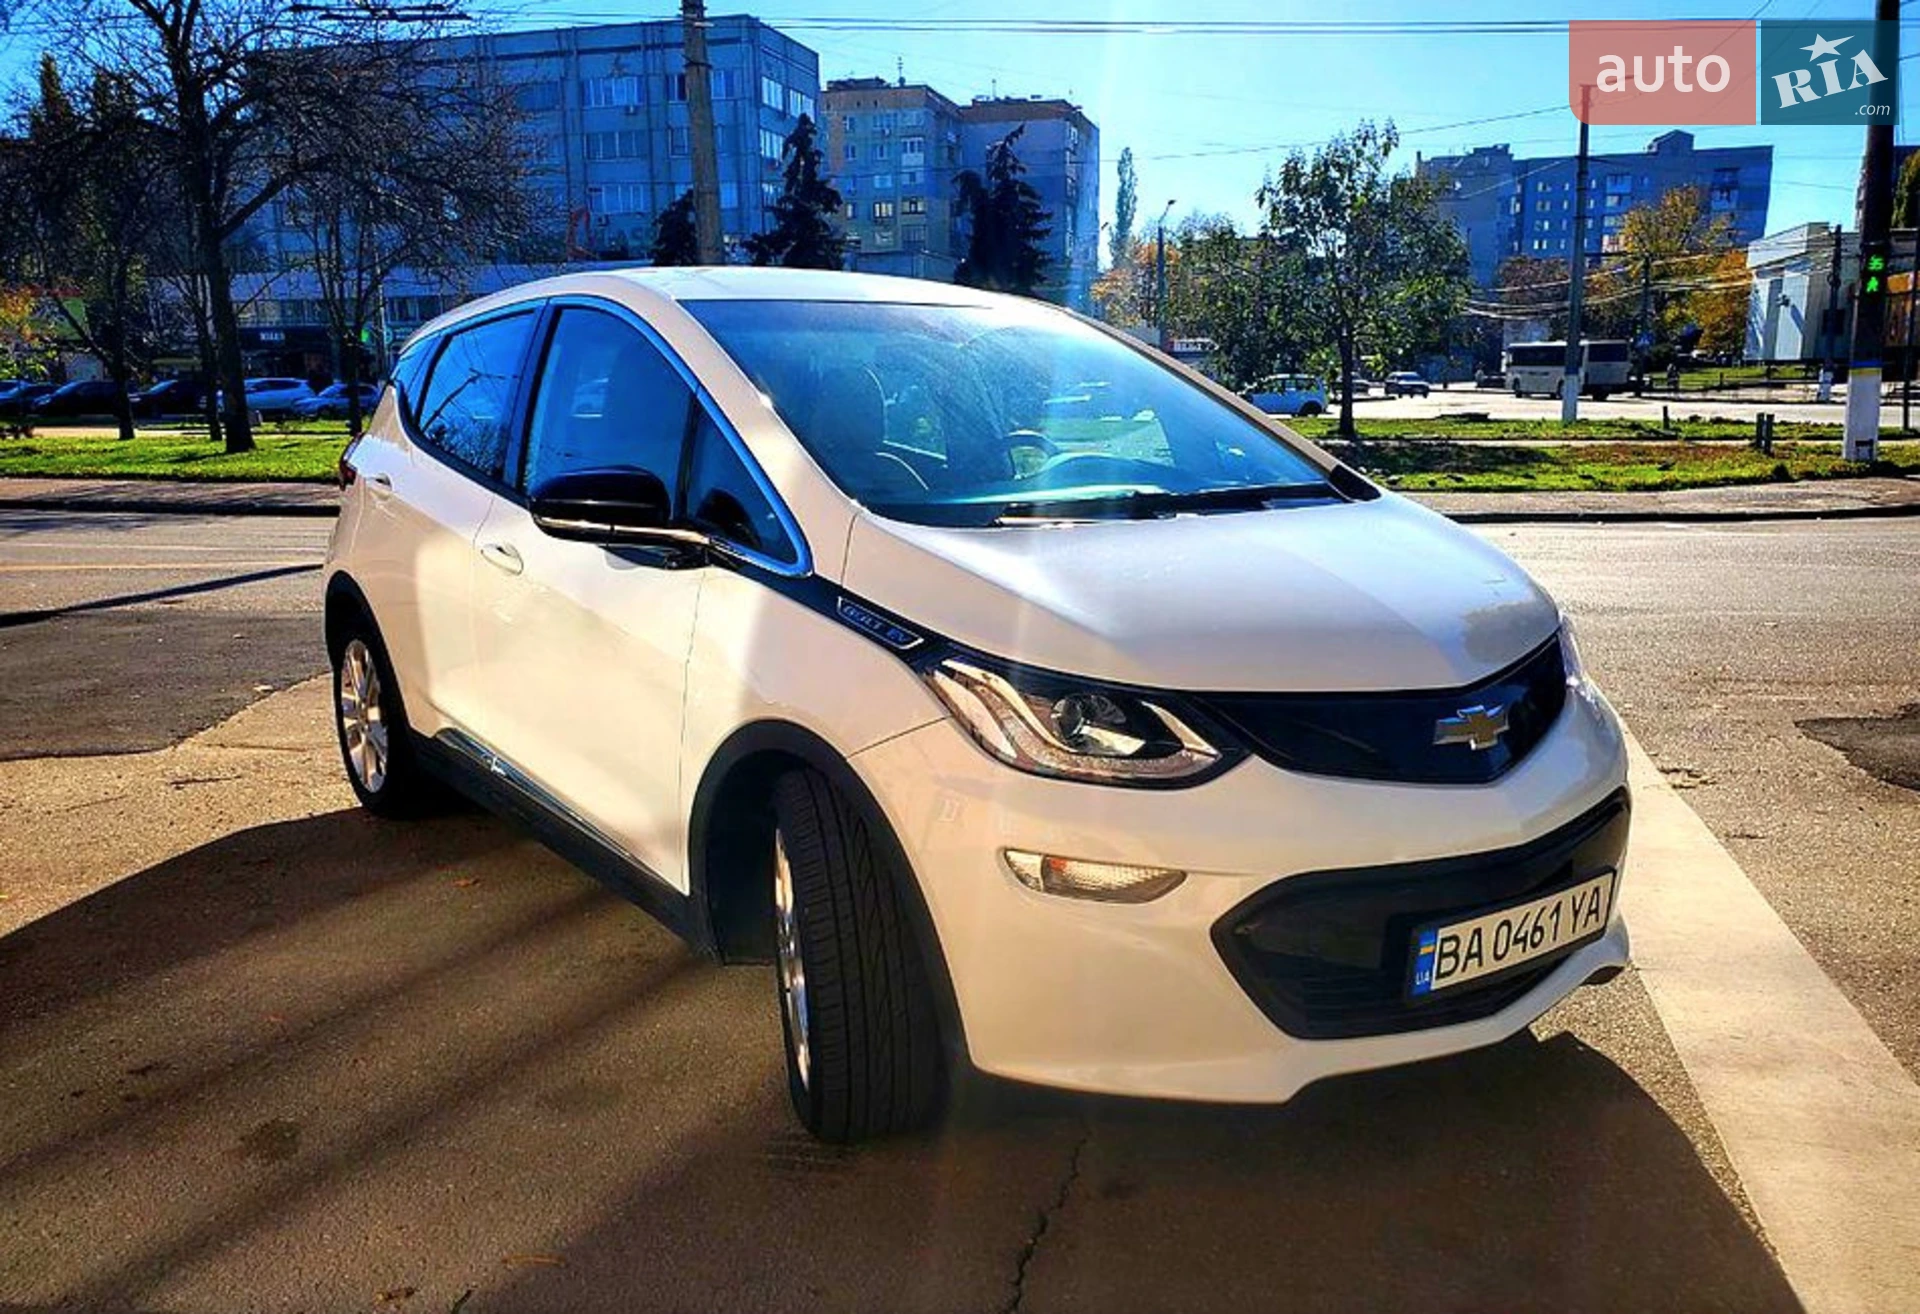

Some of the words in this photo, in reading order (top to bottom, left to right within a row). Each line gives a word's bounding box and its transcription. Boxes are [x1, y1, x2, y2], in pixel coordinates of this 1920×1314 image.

[1435, 927, 1484, 980] BA
[1492, 901, 1562, 961] 0461
[1572, 887, 1600, 934] YA
